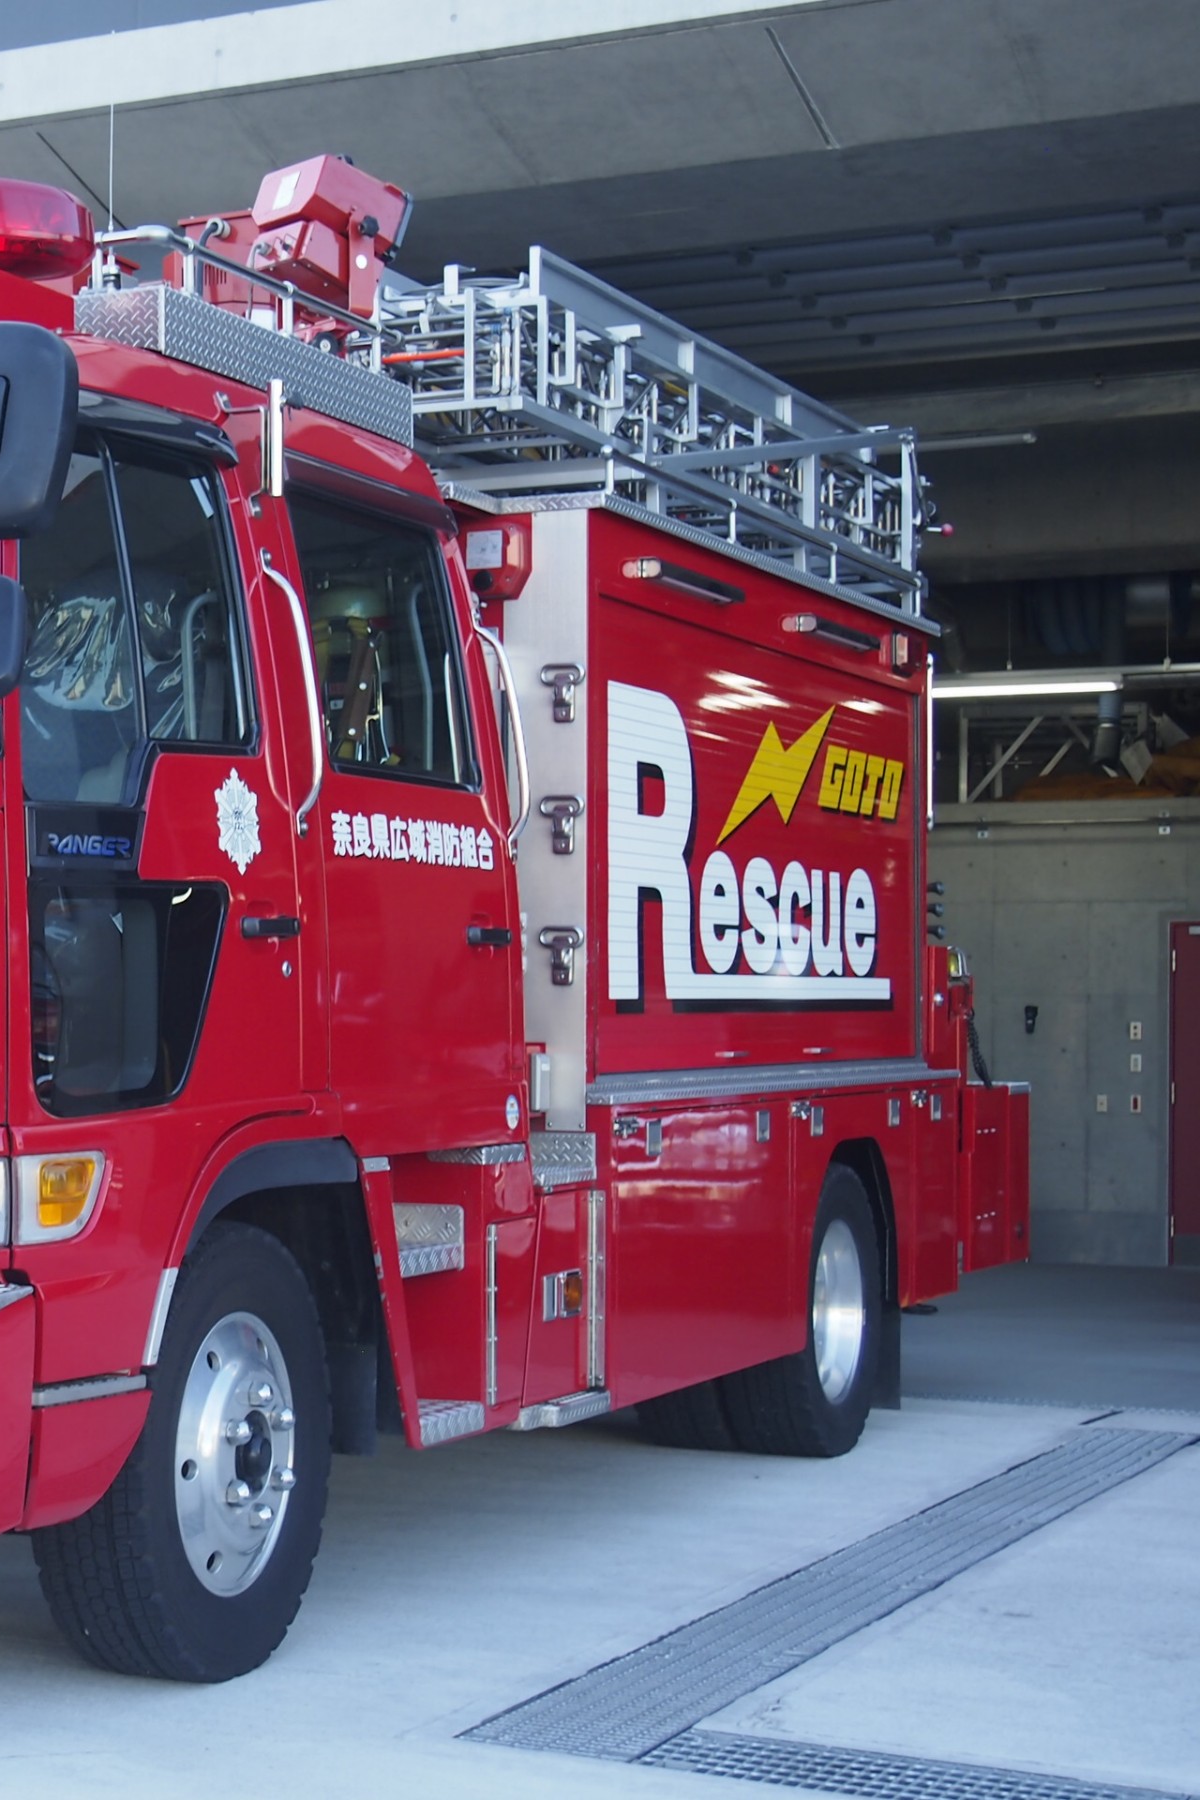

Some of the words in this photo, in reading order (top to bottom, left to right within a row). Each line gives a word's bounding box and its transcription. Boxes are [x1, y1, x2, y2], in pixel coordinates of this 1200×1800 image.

[818, 744, 904, 820] GOTO
[47, 832, 132, 859] RANGER
[330, 809, 494, 871] 奈良県広域消防組合
[607, 679, 891, 1000] Rescue
